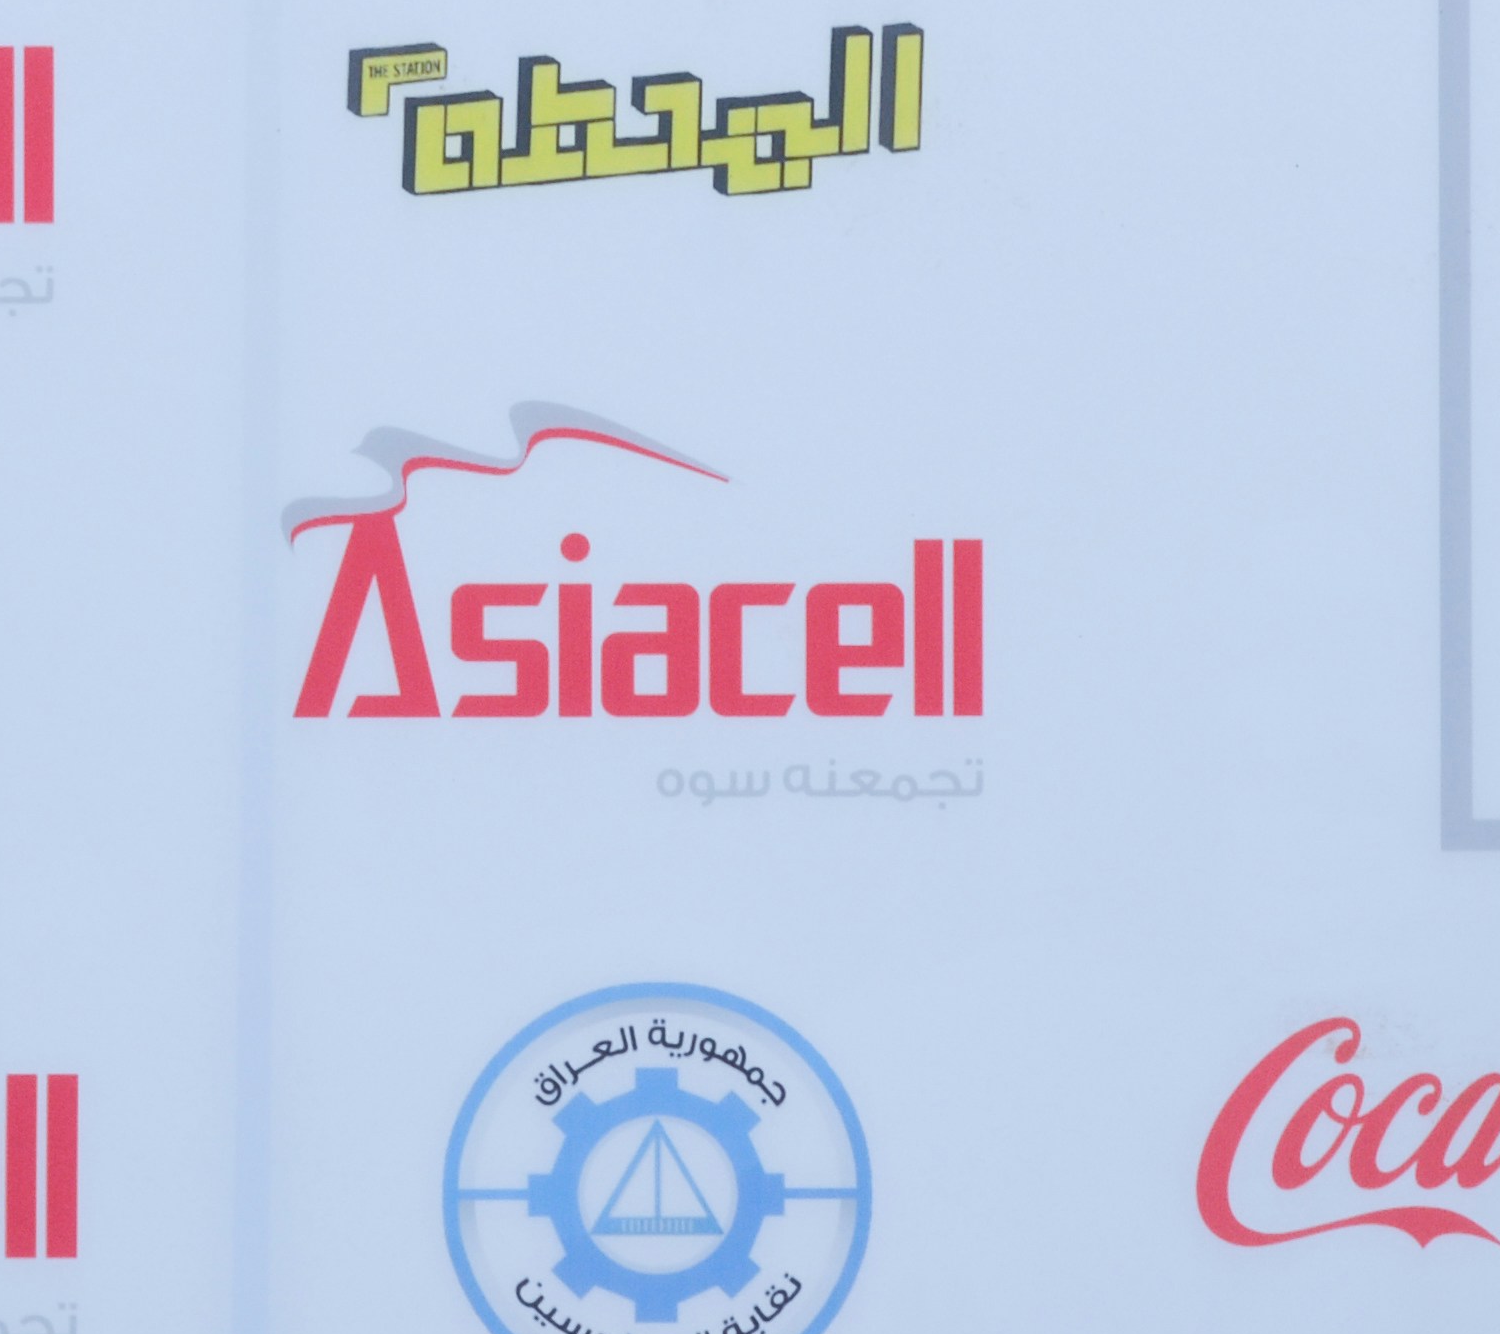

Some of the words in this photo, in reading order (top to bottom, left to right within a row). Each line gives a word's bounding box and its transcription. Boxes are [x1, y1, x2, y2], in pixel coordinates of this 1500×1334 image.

[368, 64, 389, 78] THE
[393, 59, 442, 76] STATION
[294, 512, 983, 717] Asiacell
[657, 769, 770, 805] سوه
[535, 1025, 638, 1106] العراق
[648, 1019, 786, 1106] جمهورية
